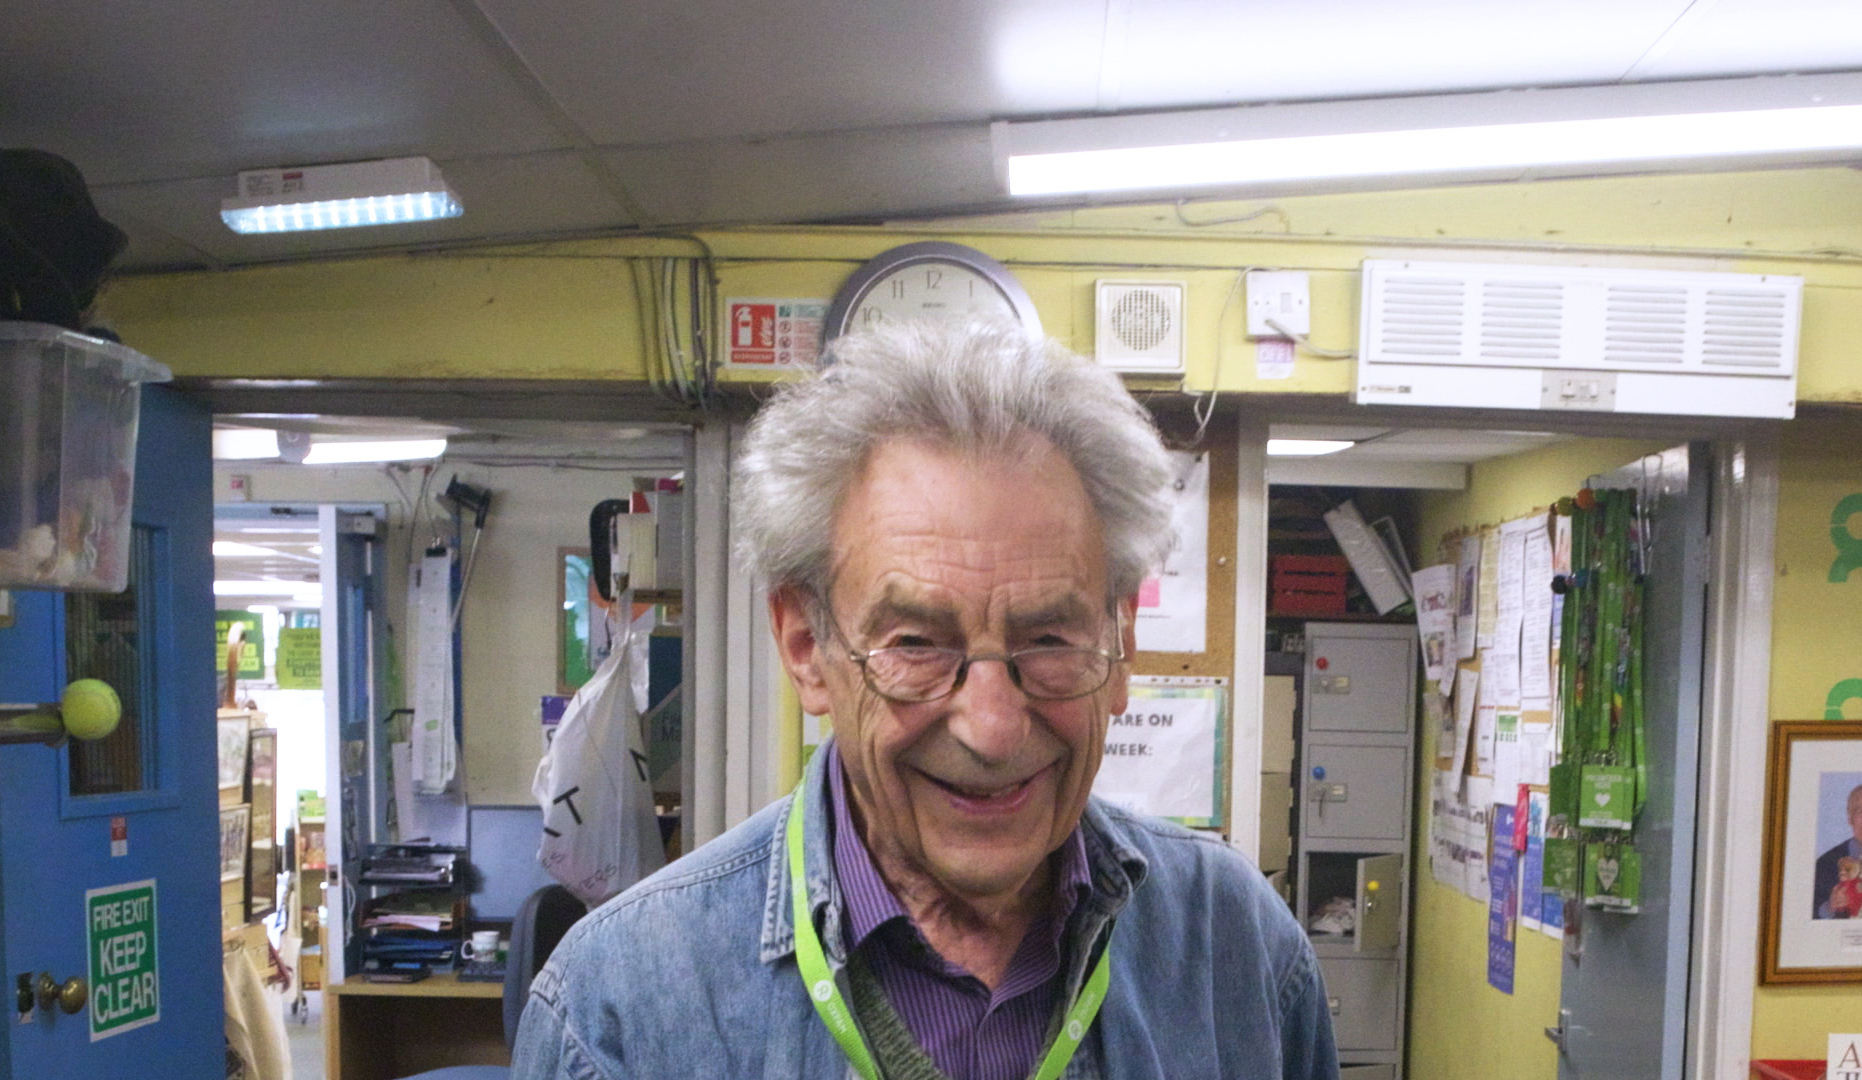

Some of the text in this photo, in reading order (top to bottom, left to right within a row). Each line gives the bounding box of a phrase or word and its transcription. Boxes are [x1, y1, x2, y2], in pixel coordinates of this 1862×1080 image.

[891, 279, 904, 299] 11
[927, 270, 942, 289] 12
[1112, 713, 1173, 727] ARE ON
[1104, 743, 1153, 756] WEEK:
[93, 897, 150, 931] FIRE EXIT
[100, 931, 147, 977] KEEP
[94, 971, 156, 1024] CLEAR
